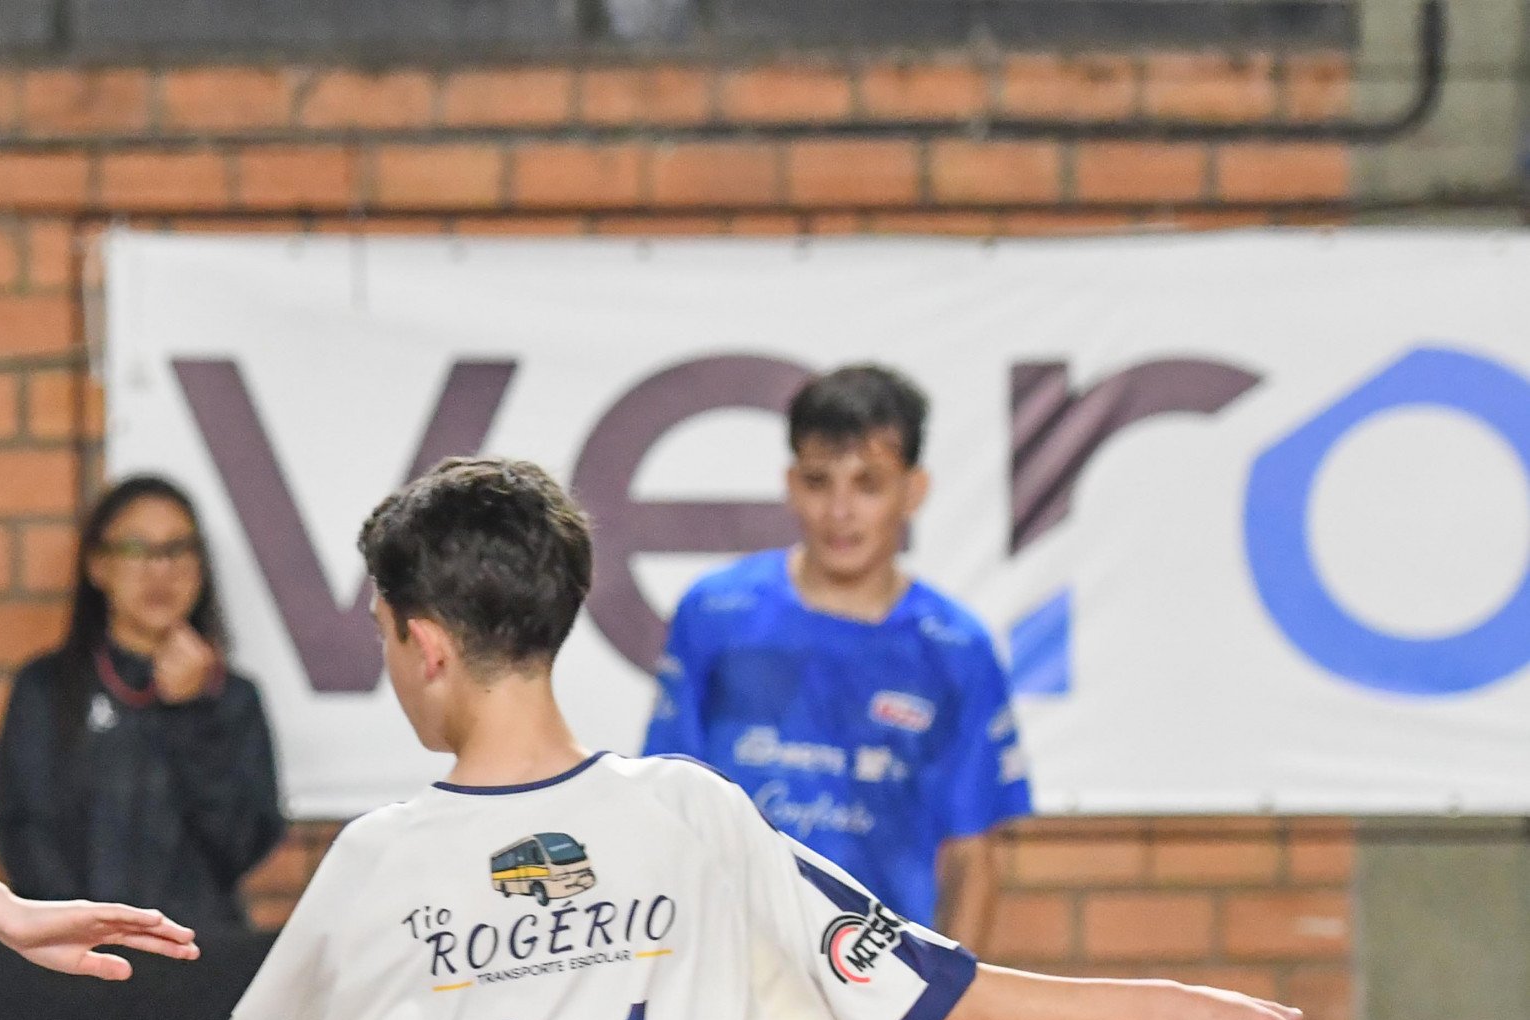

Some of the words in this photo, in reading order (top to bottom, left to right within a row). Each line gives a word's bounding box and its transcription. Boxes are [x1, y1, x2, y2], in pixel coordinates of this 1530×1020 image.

[170, 342, 1530, 698] vero
[402, 905, 452, 938] Tio
[425, 894, 676, 976] ROGÉRIO
[476, 959, 565, 984] TRANSPORTE
